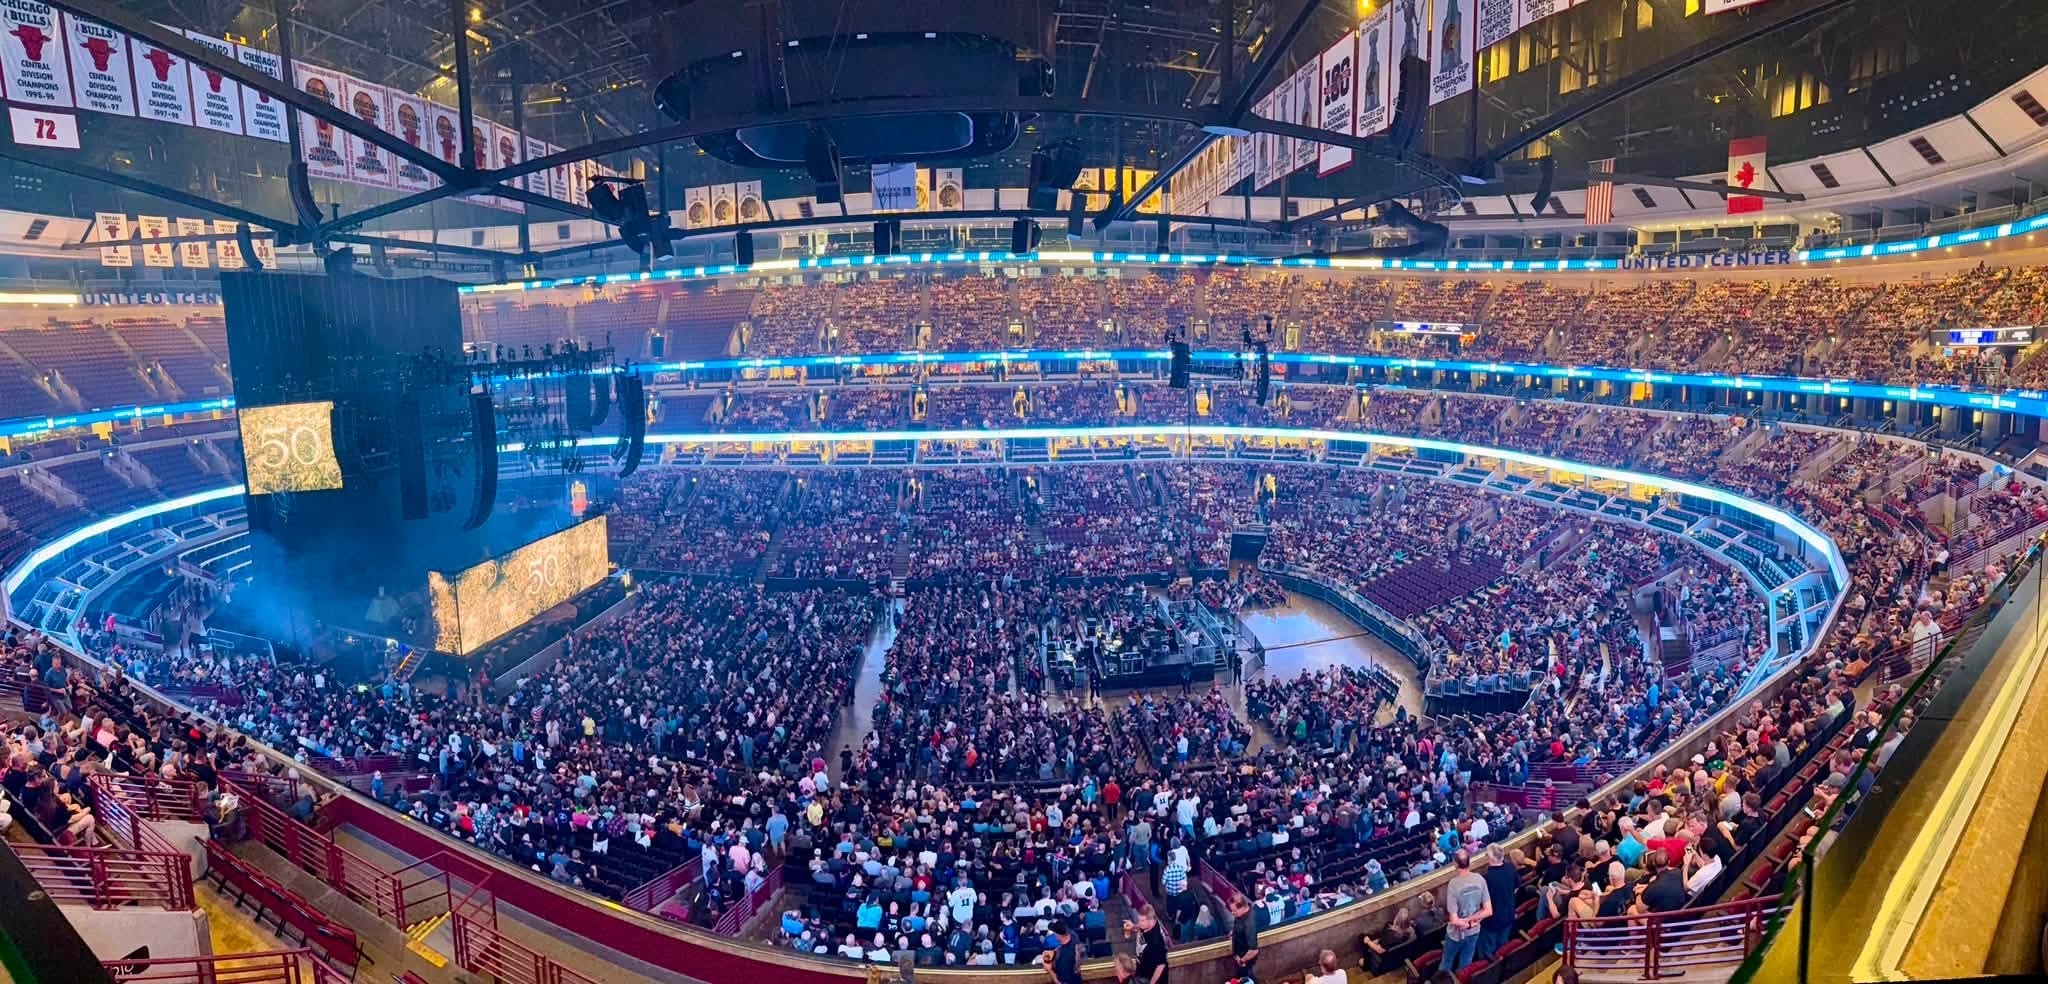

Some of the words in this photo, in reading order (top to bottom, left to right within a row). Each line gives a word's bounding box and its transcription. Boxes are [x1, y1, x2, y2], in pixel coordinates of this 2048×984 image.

[10, 10, 46, 26] BULLS
[80, 23, 113, 39] BULLS
[21, 59, 51, 71] CENTRAL
[21, 70, 54, 81] DIVISION
[88, 71, 115, 83] CENTRAL
[1433, 70, 1455, 86] STANLEY
[1457, 62, 1469, 75] CUP
[17, 79, 60, 91] CHAMPIONS
[88, 81, 118, 93] DIVISION
[151, 81, 175, 92] CENTRAL
[1434, 72, 1467, 94] CHAMPIONS
[85, 89, 123, 103] CHAMPIONS
[151, 90, 177, 101] DIVISION
[148, 99, 183, 111] CHAMPIONS
[34, 117, 57, 140] 72
[223, 245, 236, 257] 23
[1622, 255, 1691, 270] UNITED
[1711, 251, 1791, 267] CENTER
[259, 426, 321, 467] 50
[528, 554, 559, 595] 50
[961, 898, 970, 907] 11
